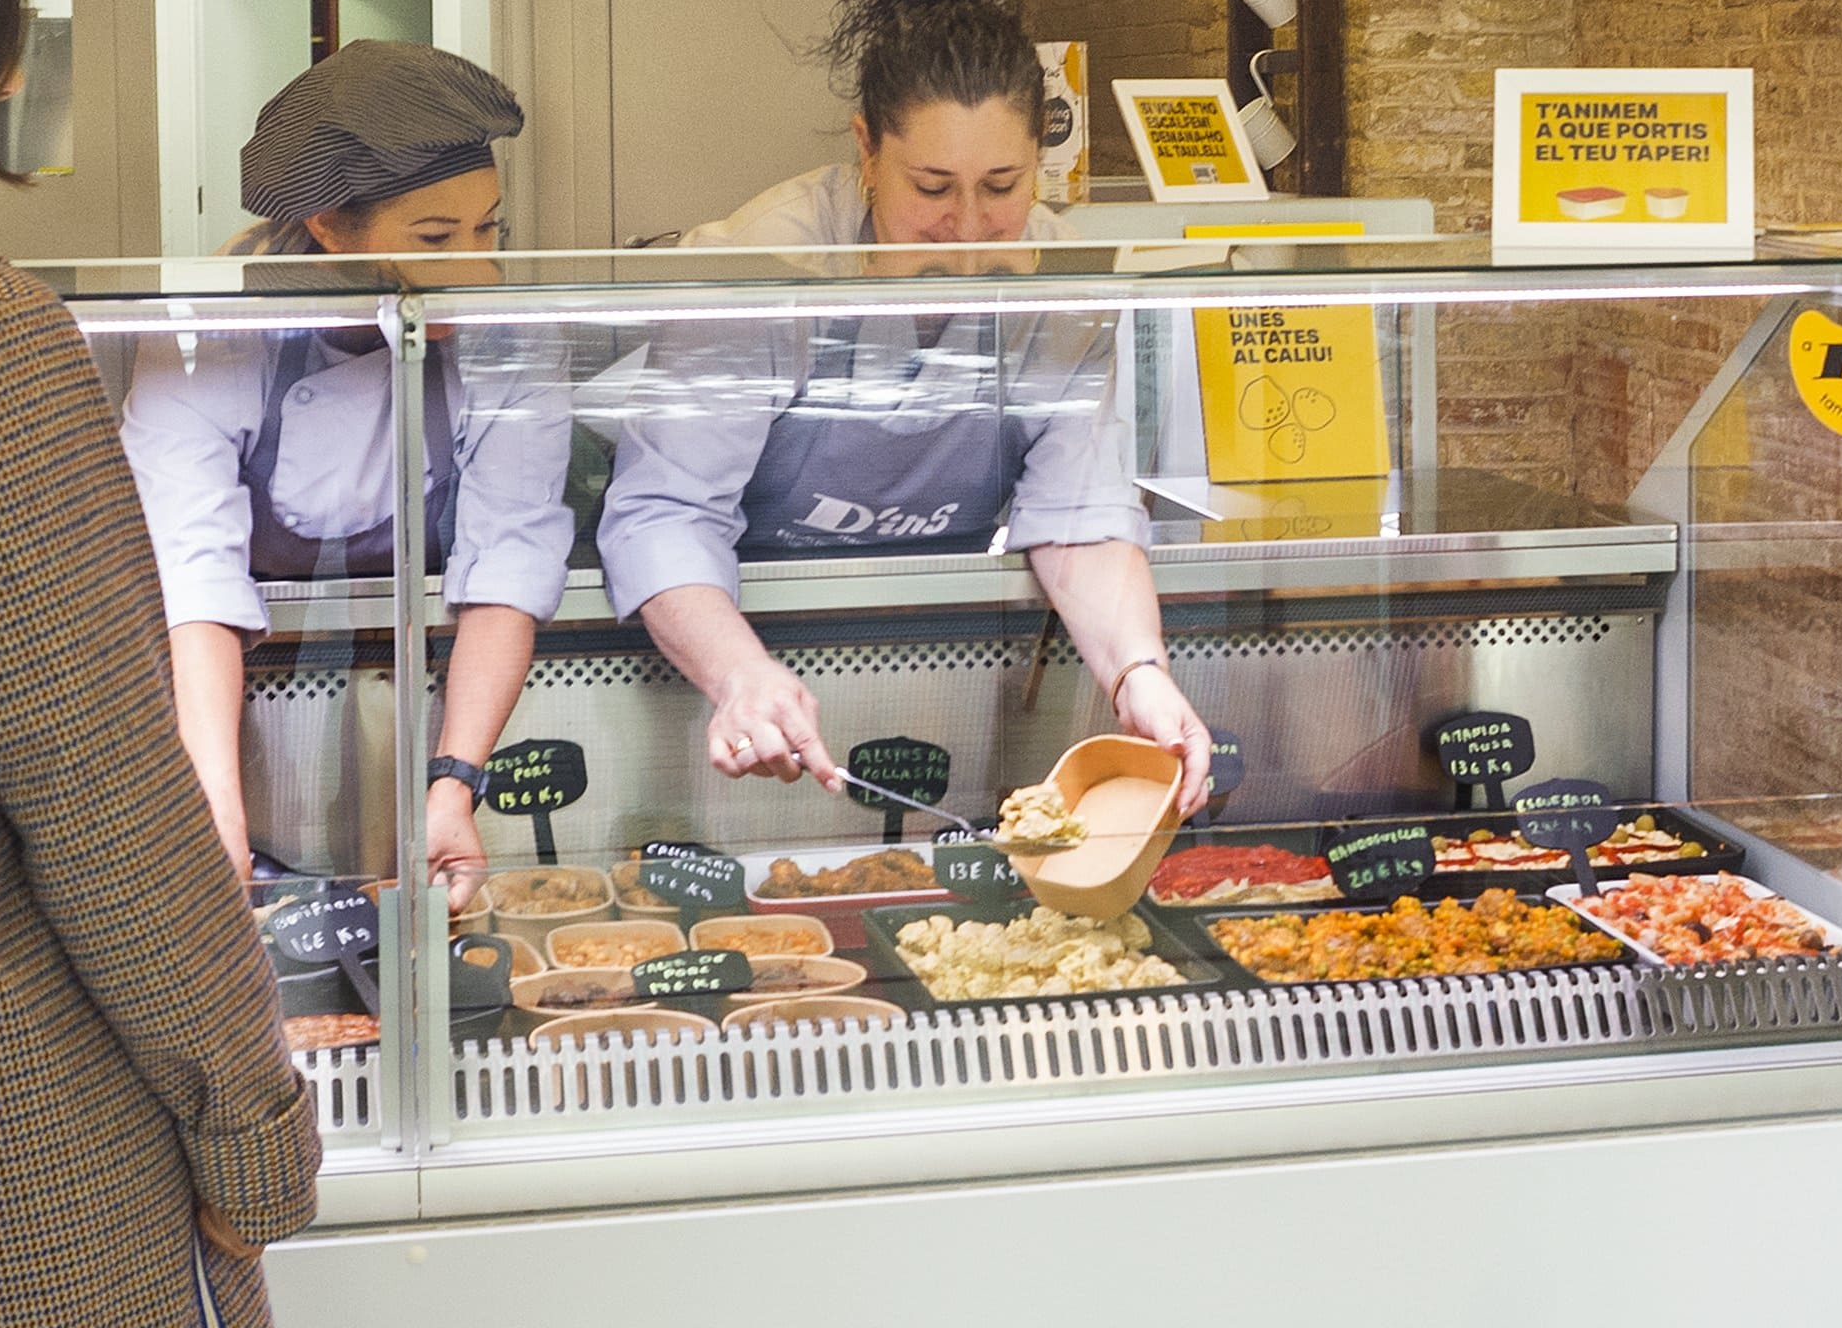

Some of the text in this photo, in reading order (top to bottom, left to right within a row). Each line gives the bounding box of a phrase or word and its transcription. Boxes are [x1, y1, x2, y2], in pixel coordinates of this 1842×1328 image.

[1536, 103, 1658, 119] T'ANIMEM
[1535, 123, 1708, 140] A QUE PORTIS
[1535, 145, 1564, 161] EL
[1569, 145, 1617, 161] TEU
[1230, 312, 1285, 328] UNES
[1231, 330, 1319, 346] PATATES
[1233, 346, 1332, 364] AL CALIU!
